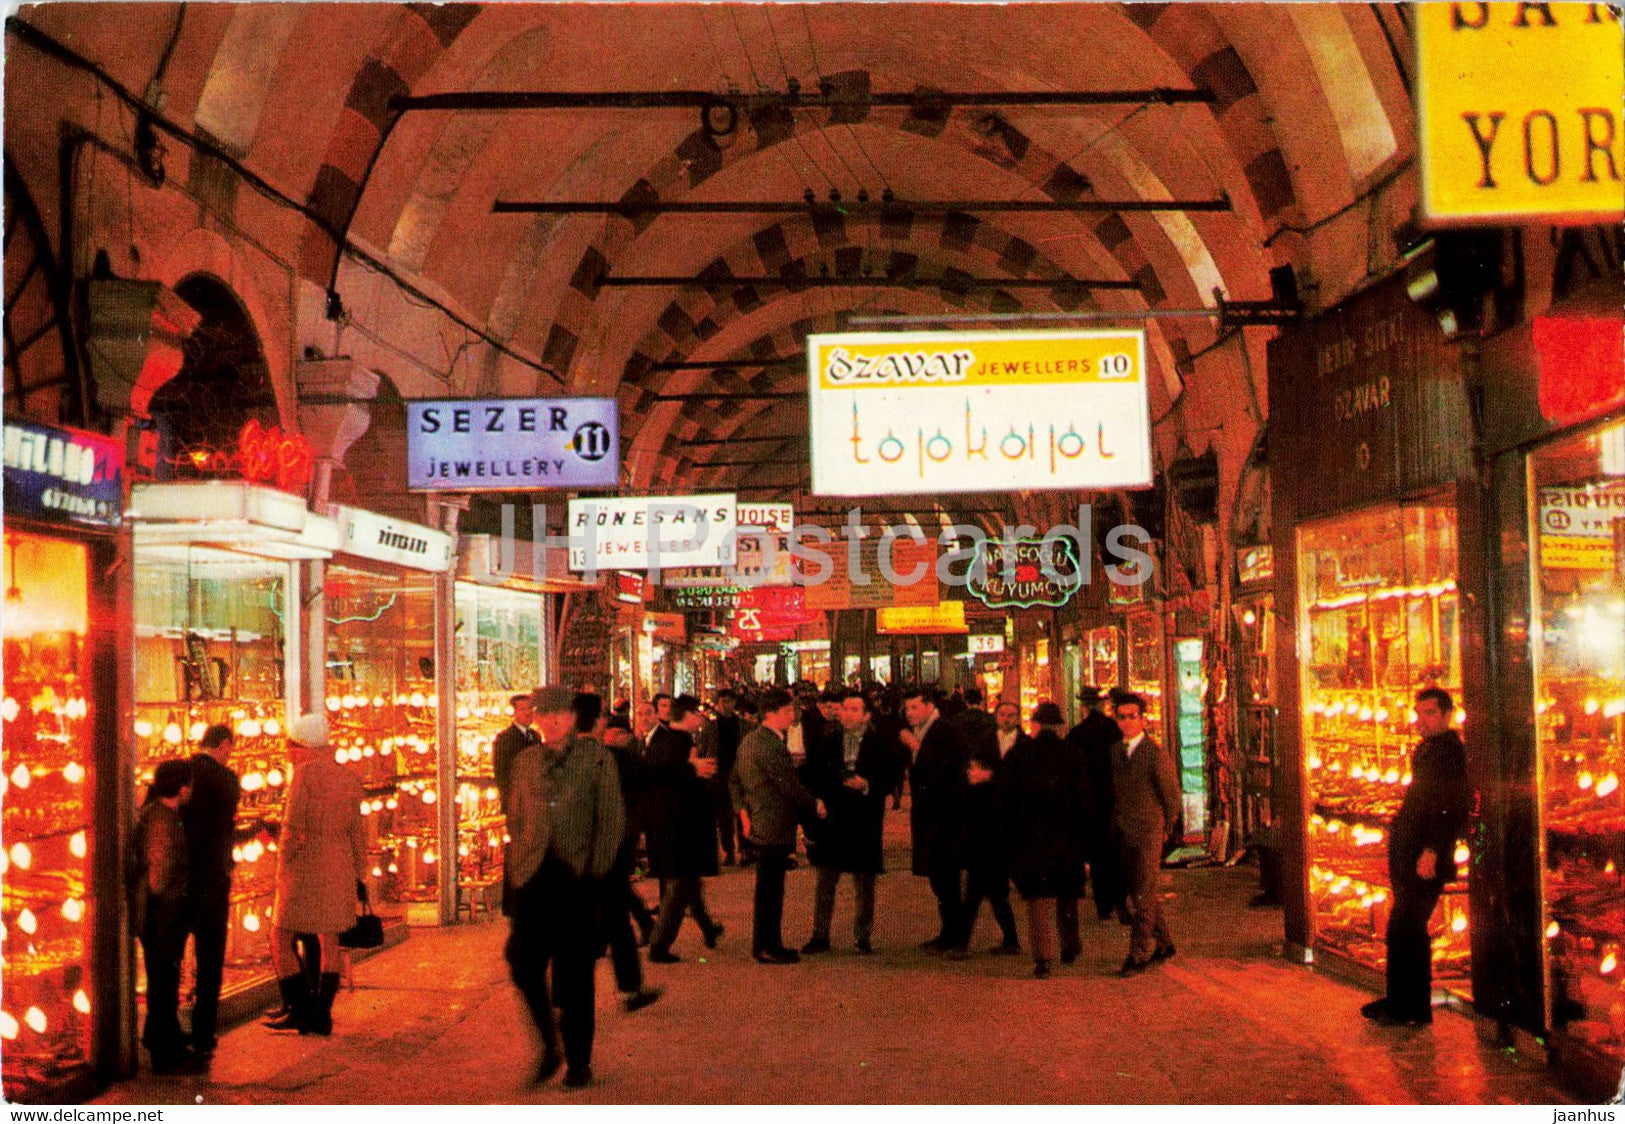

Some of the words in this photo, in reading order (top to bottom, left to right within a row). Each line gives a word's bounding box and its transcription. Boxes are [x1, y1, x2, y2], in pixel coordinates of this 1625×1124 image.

[978, 359, 1092, 376] JEWELLERS
[1102, 355, 1129, 374] 10
[421, 407, 568, 433] SEZER
[576, 507, 728, 527] RÖNESANS
[597, 539, 706, 555] JEWELLERY
[717, 545, 732, 561] 13
[573, 550, 587, 566] 13
